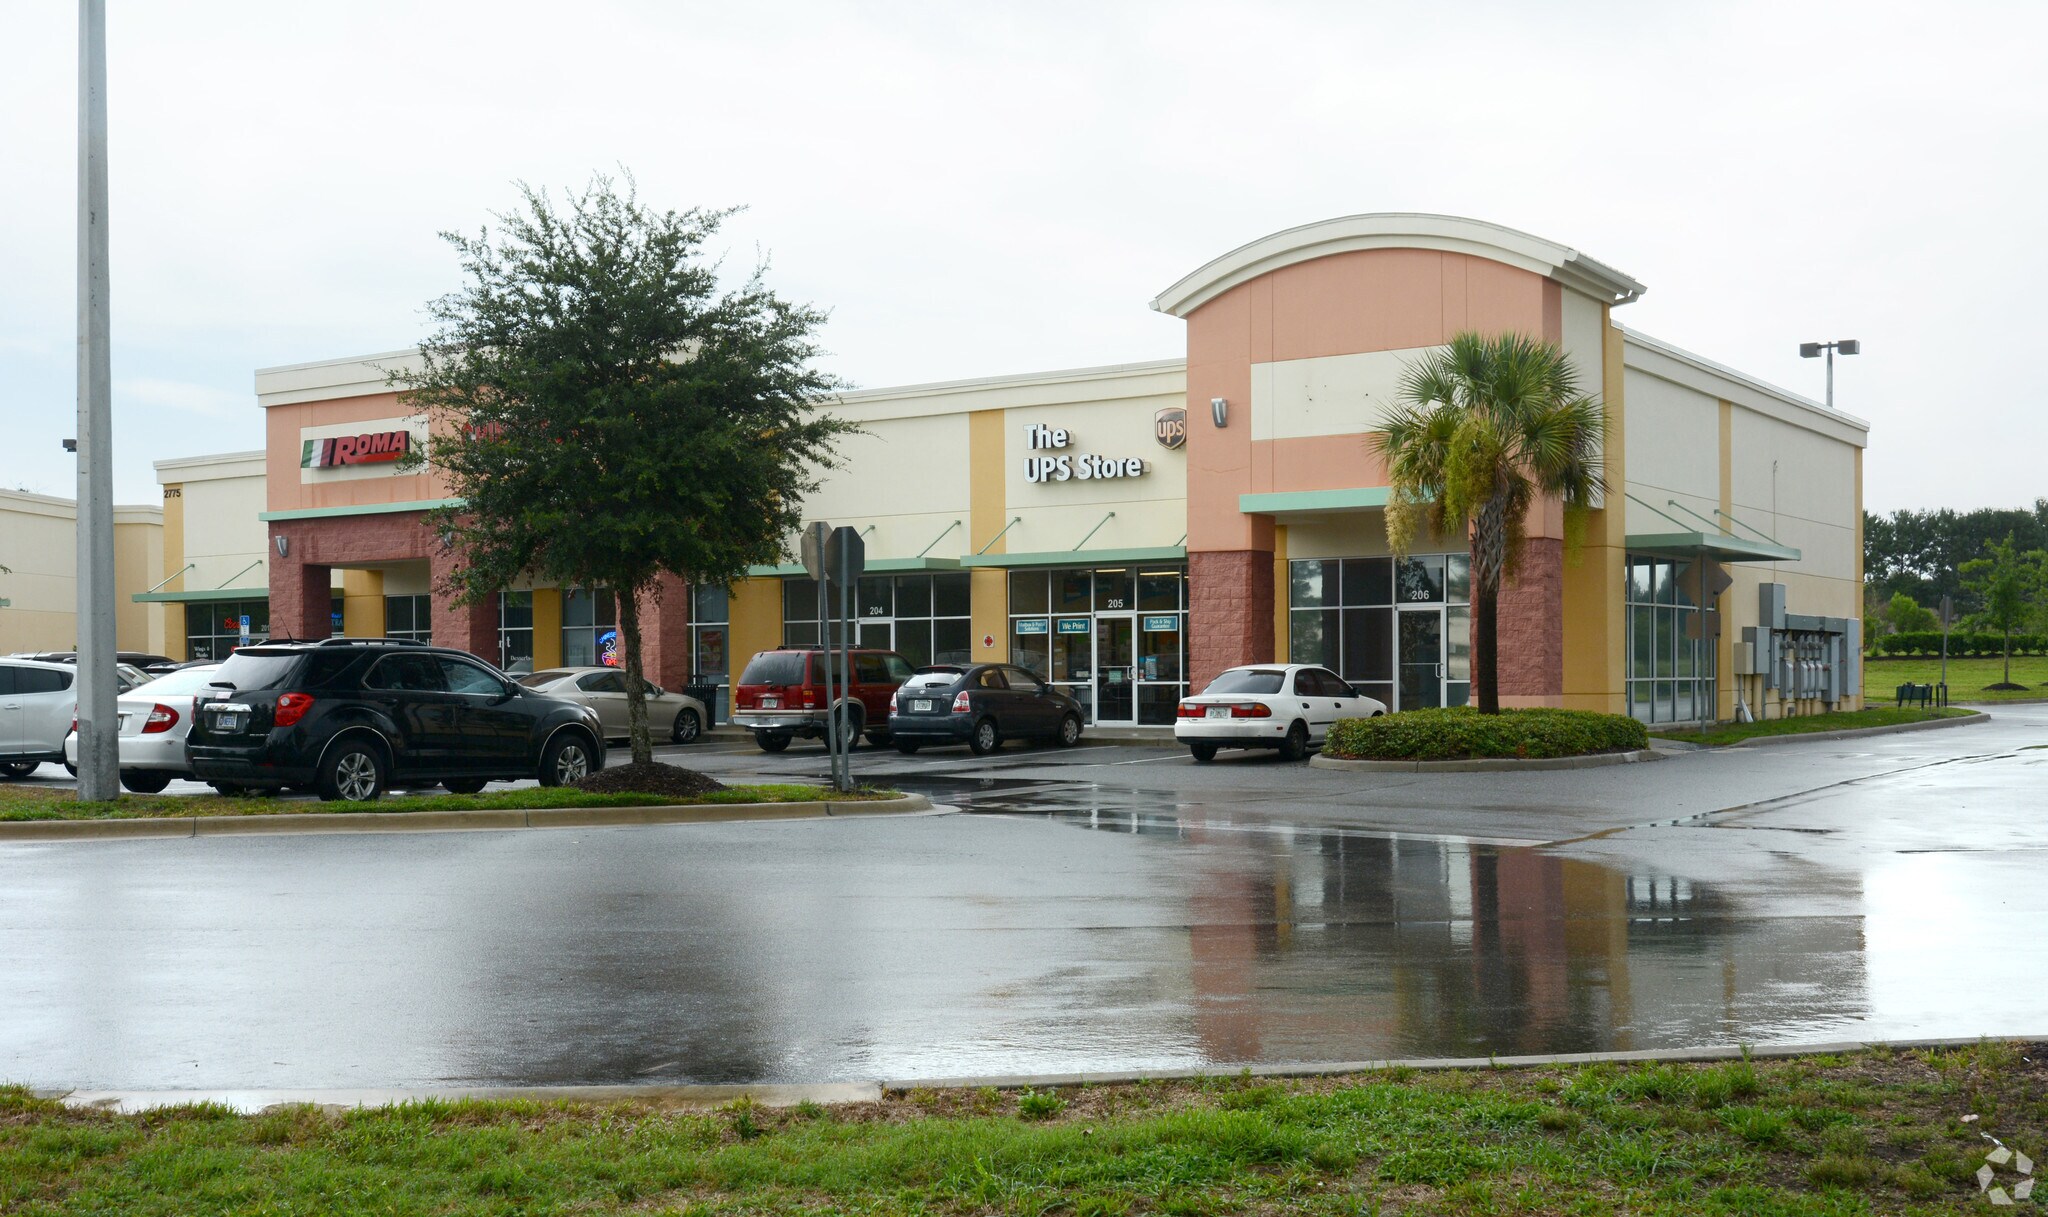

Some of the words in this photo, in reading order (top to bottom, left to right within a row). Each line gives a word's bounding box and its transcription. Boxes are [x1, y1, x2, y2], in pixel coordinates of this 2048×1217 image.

[1023, 423, 1069, 449] The
[1157, 419, 1184, 443] ups
[333, 430, 409, 466] ROMA
[1023, 455, 1072, 483] UPS
[1077, 453, 1143, 480] Store
[164, 488, 181, 498] 2775
[1411, 589, 1430, 600] 206
[1107, 598, 1124, 608] 205
[869, 606, 884, 615] 204
[1072, 621, 1085, 629] Print
